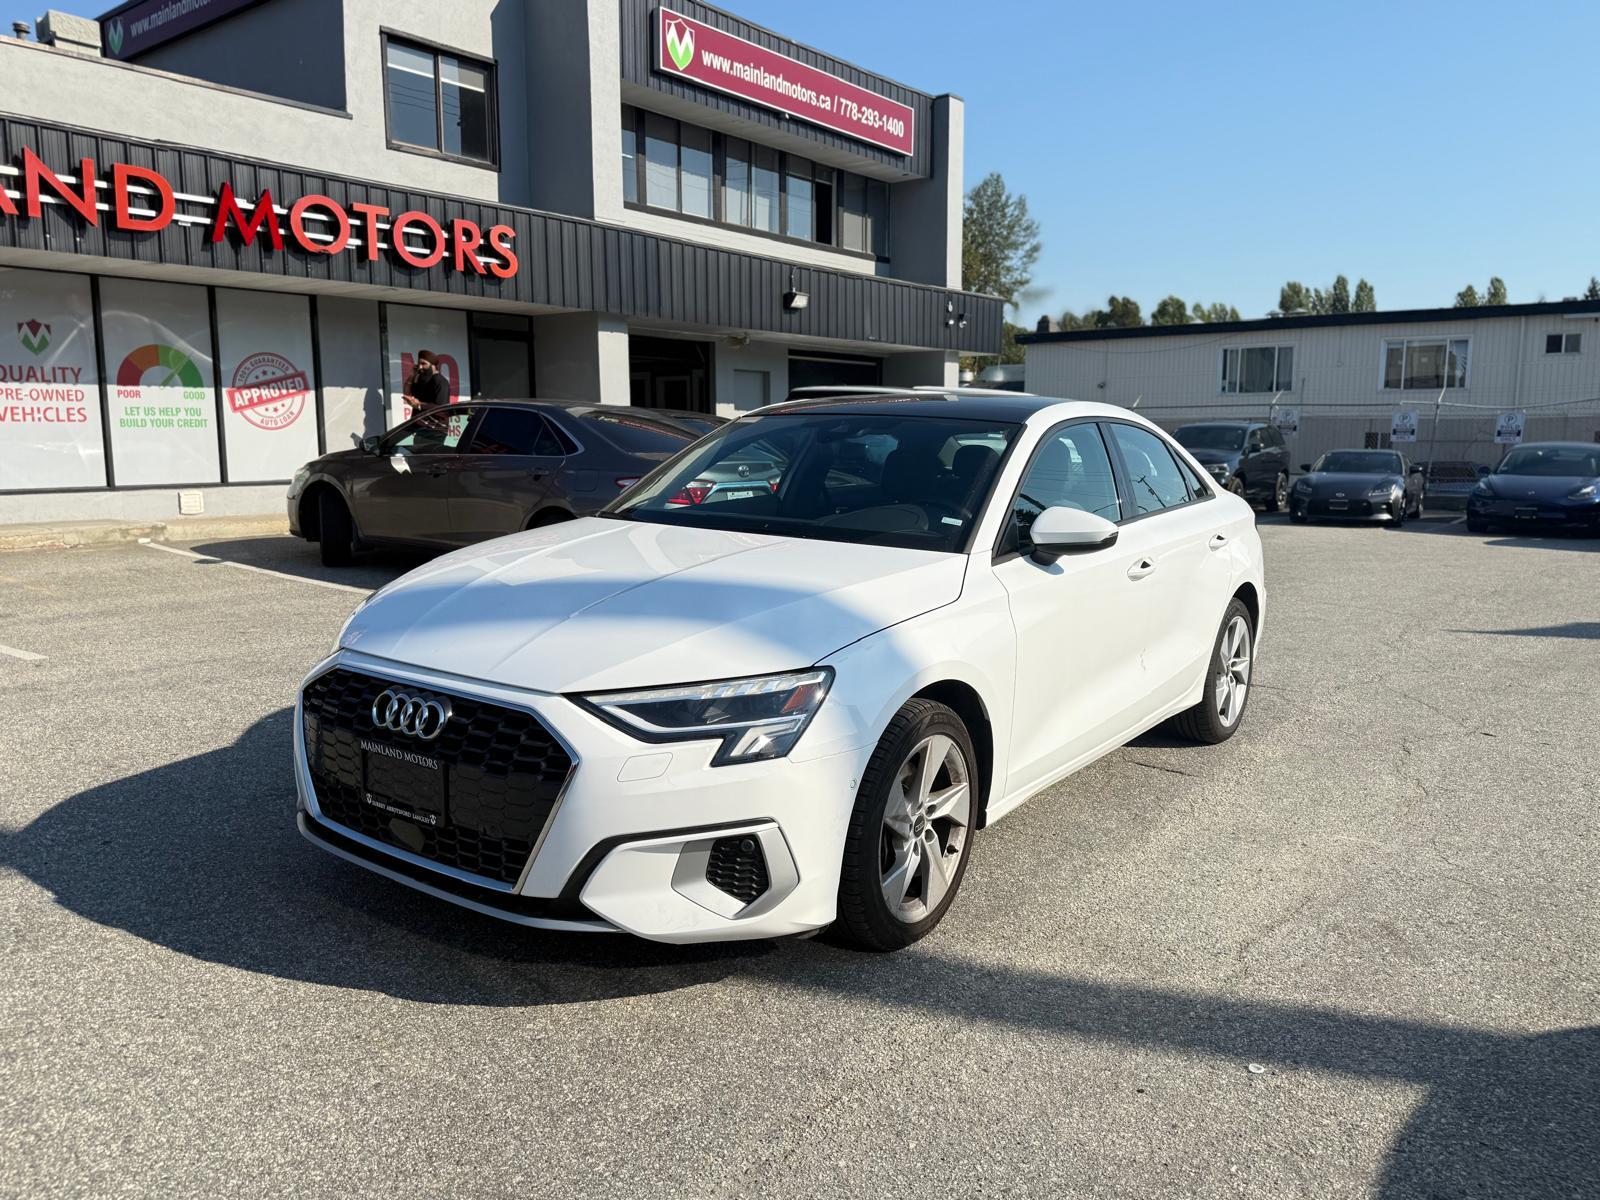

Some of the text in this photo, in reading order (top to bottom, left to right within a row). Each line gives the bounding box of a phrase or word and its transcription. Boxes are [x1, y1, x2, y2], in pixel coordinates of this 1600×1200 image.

[701, 49, 904, 138] www.mainlandmotors.ca / 778-293-1400
[211, 181, 519, 278] MOTORS
[117, 389, 206, 401] POOR GOOD
[234, 376, 305, 408] APPROVED
[124, 406, 202, 417] LET US HELP YOU
[260, 411, 295, 426] AUTO LOAN
[120, 418, 209, 429] BUILD YOUR CREDIT
[360, 740, 439, 770] MAINLAND MOTORS
